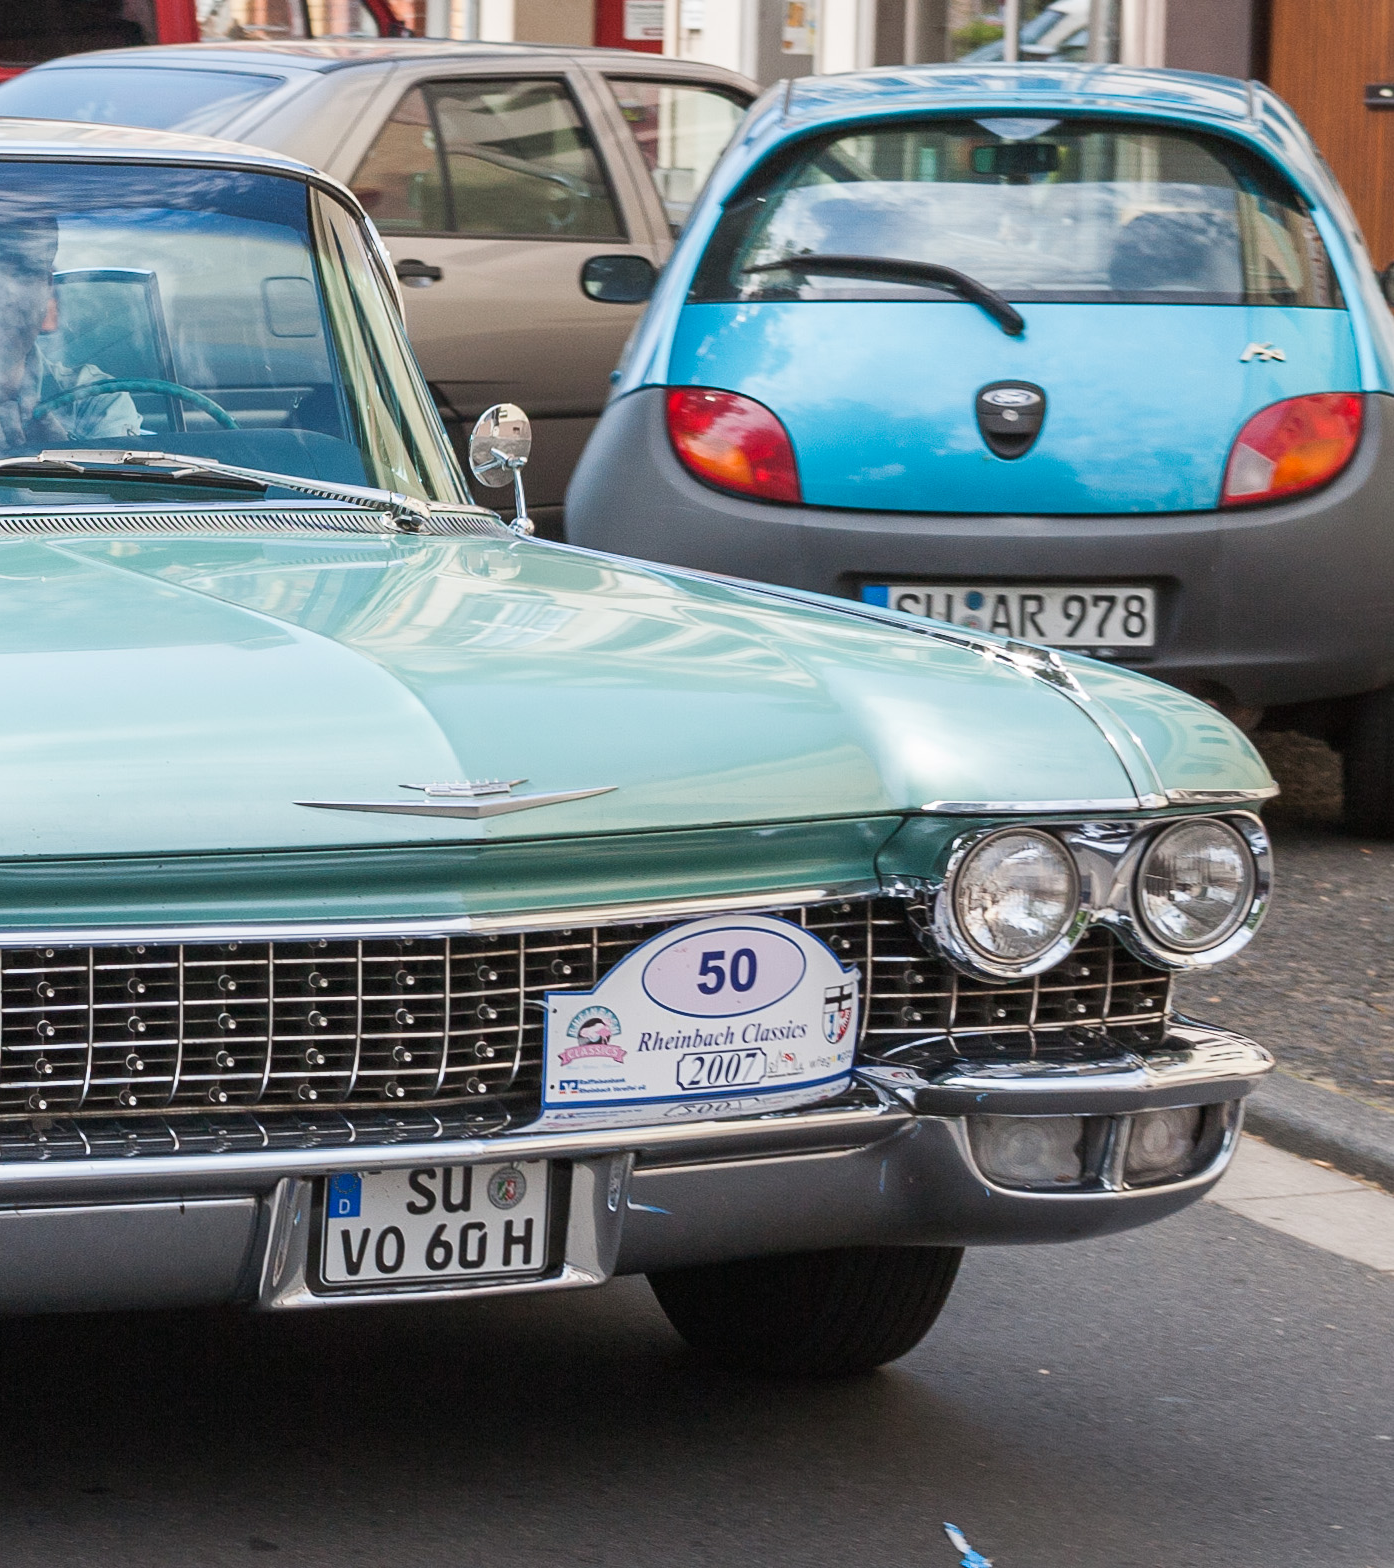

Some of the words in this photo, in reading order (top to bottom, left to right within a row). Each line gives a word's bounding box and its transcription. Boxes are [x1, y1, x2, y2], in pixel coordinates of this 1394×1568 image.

[992, 594, 1047, 637] AR
[1063, 594, 1147, 638] 978
[696, 947, 758, 995] 50
[637, 1025, 735, 1053] Rheinbach
[741, 1019, 809, 1044] Classics
[687, 1051, 758, 1087] 2007
[338, 1198, 351, 1215] D
[406, 1166, 473, 1215] SU
[341, 1225, 405, 1276] VO
[425, 1221, 488, 1271] 60
[502, 1217, 534, 1267] H
